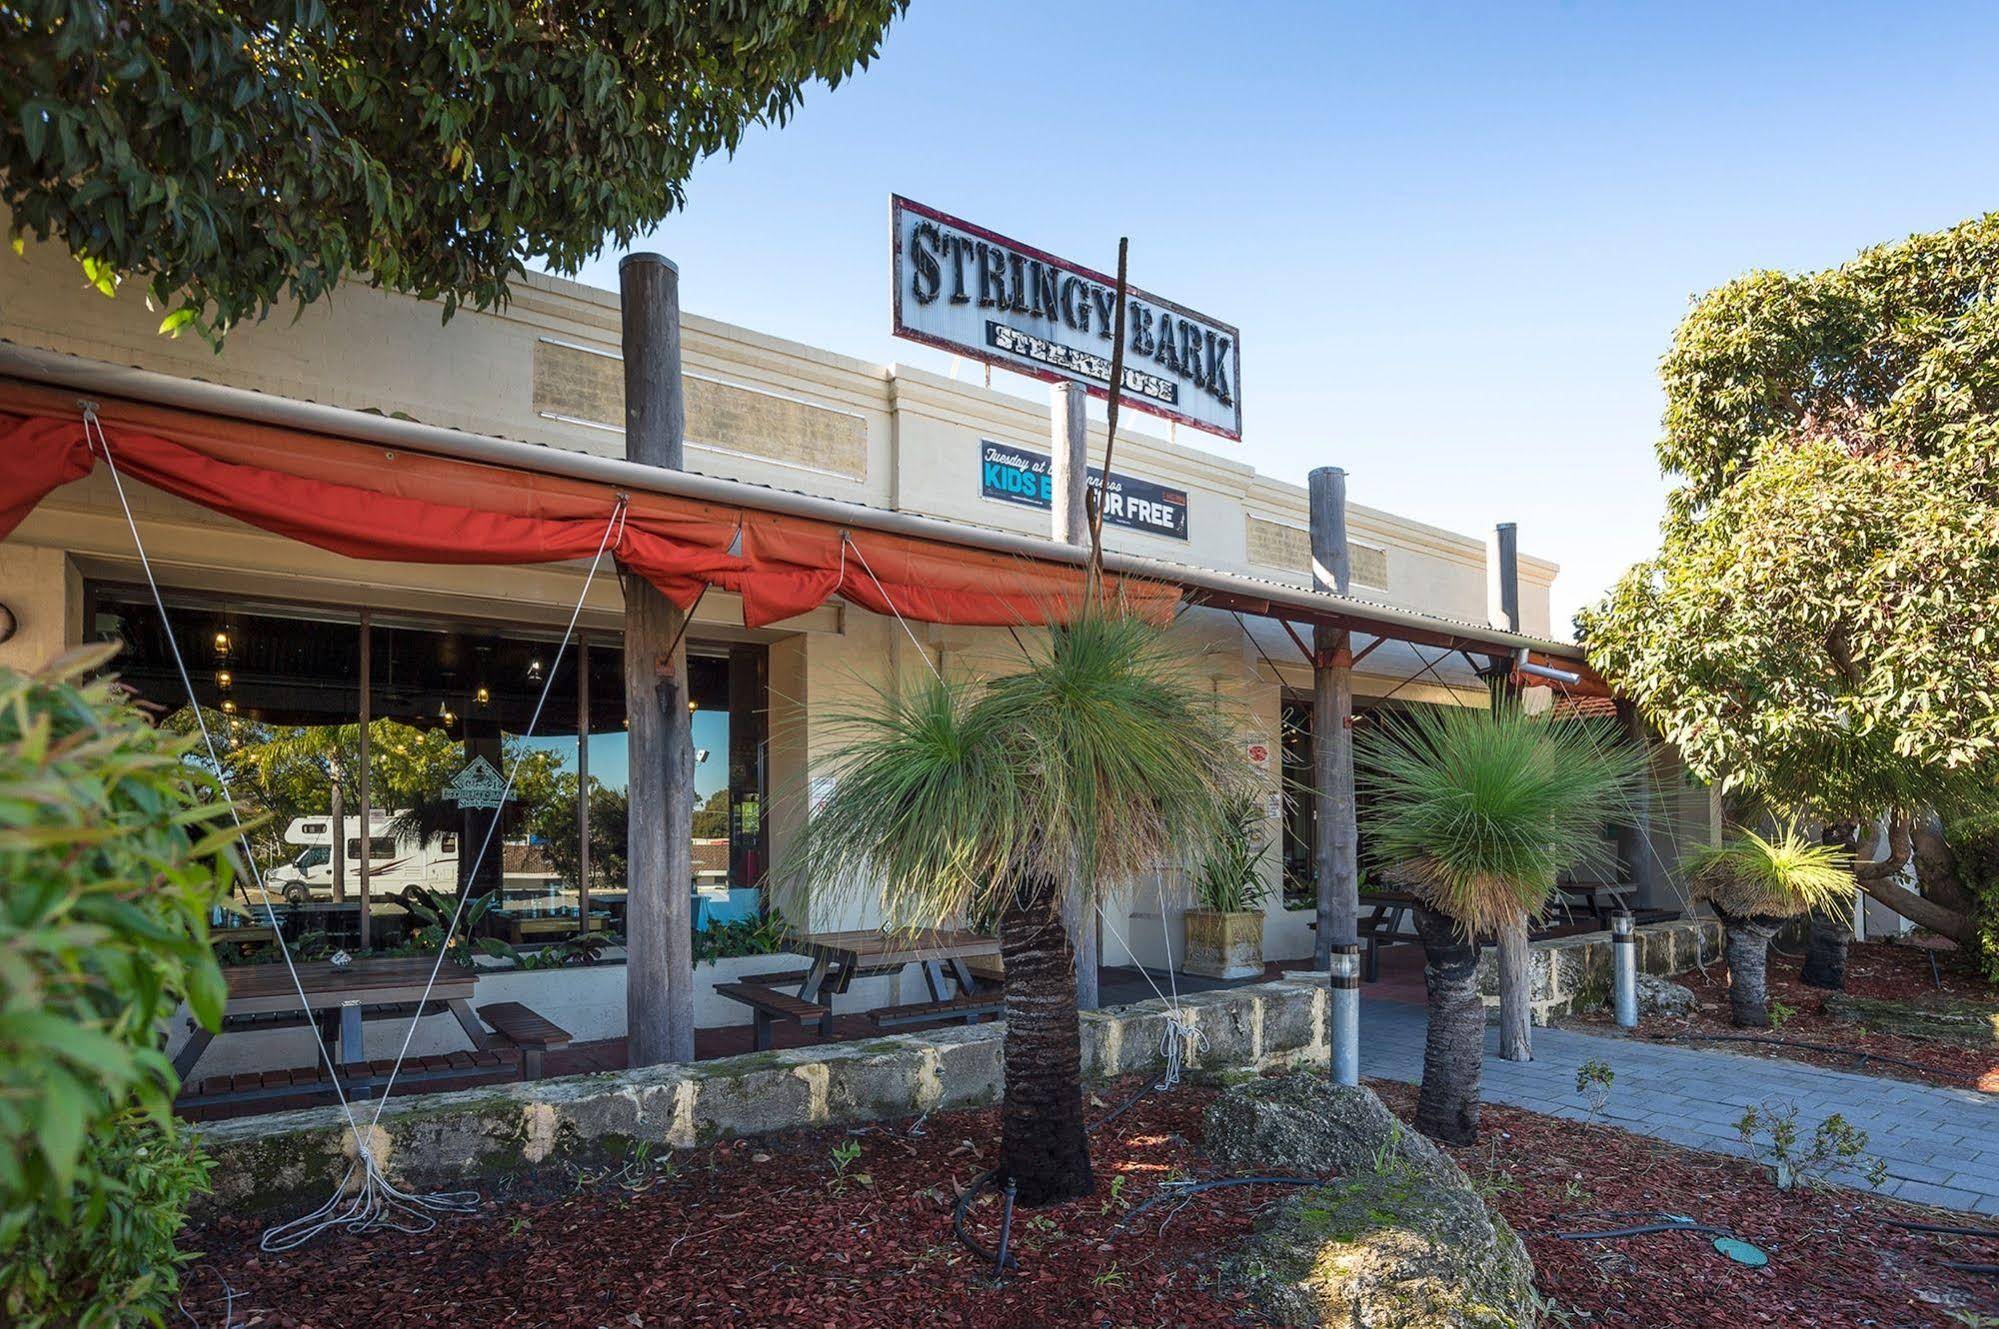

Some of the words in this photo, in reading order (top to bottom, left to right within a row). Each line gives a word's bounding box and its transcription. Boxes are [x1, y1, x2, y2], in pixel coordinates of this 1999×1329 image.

[911, 219, 1117, 340] STRINGY
[1129, 300, 1235, 408] BARK
[995, 325, 1174, 403] STEAKHUSE
[984, 448, 1030, 473] Tuesday
[1031, 461, 1046, 473] at
[985, 463, 1037, 496] KIDS
[1127, 496, 1174, 529] FREE
